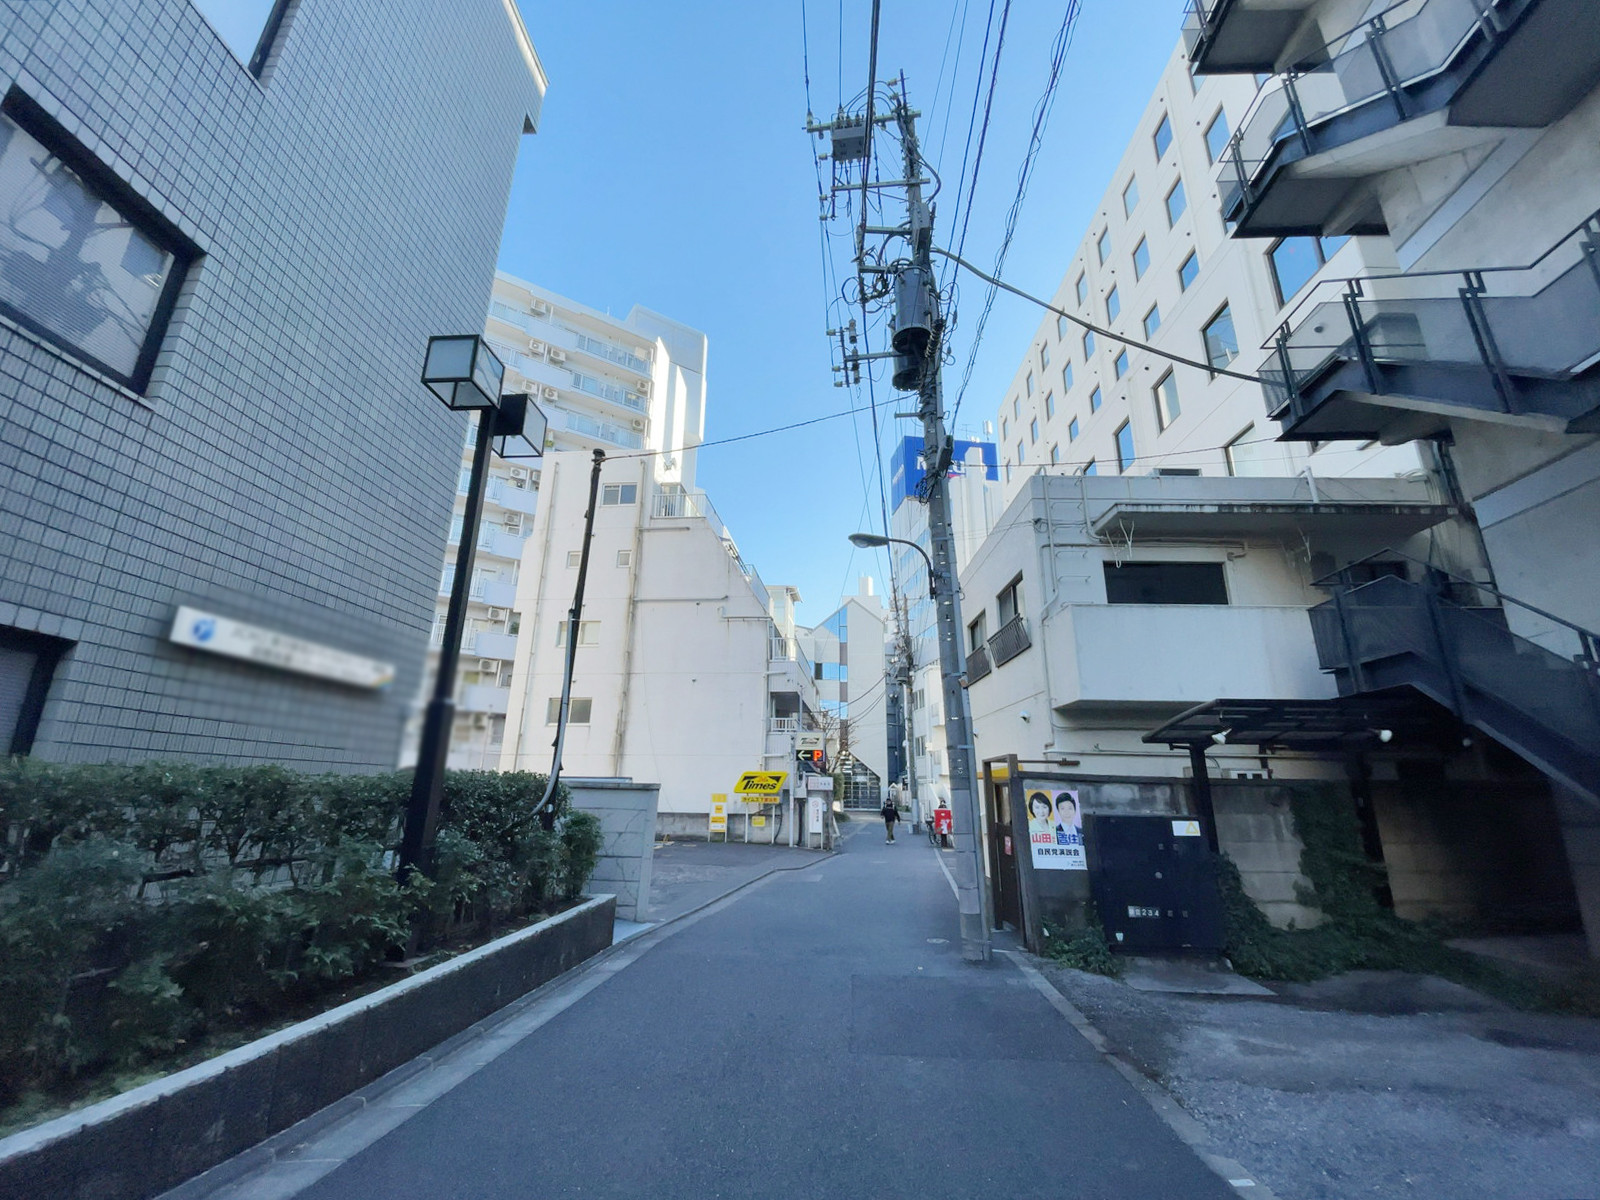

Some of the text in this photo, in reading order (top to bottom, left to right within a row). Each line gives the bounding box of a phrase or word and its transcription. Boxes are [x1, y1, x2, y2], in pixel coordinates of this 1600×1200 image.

[813, 750, 822, 761] P
[742, 776, 781, 790] Times
[1032, 833, 1051, 843] 山田
[1038, 848, 1080, 856] 自民党演説会
